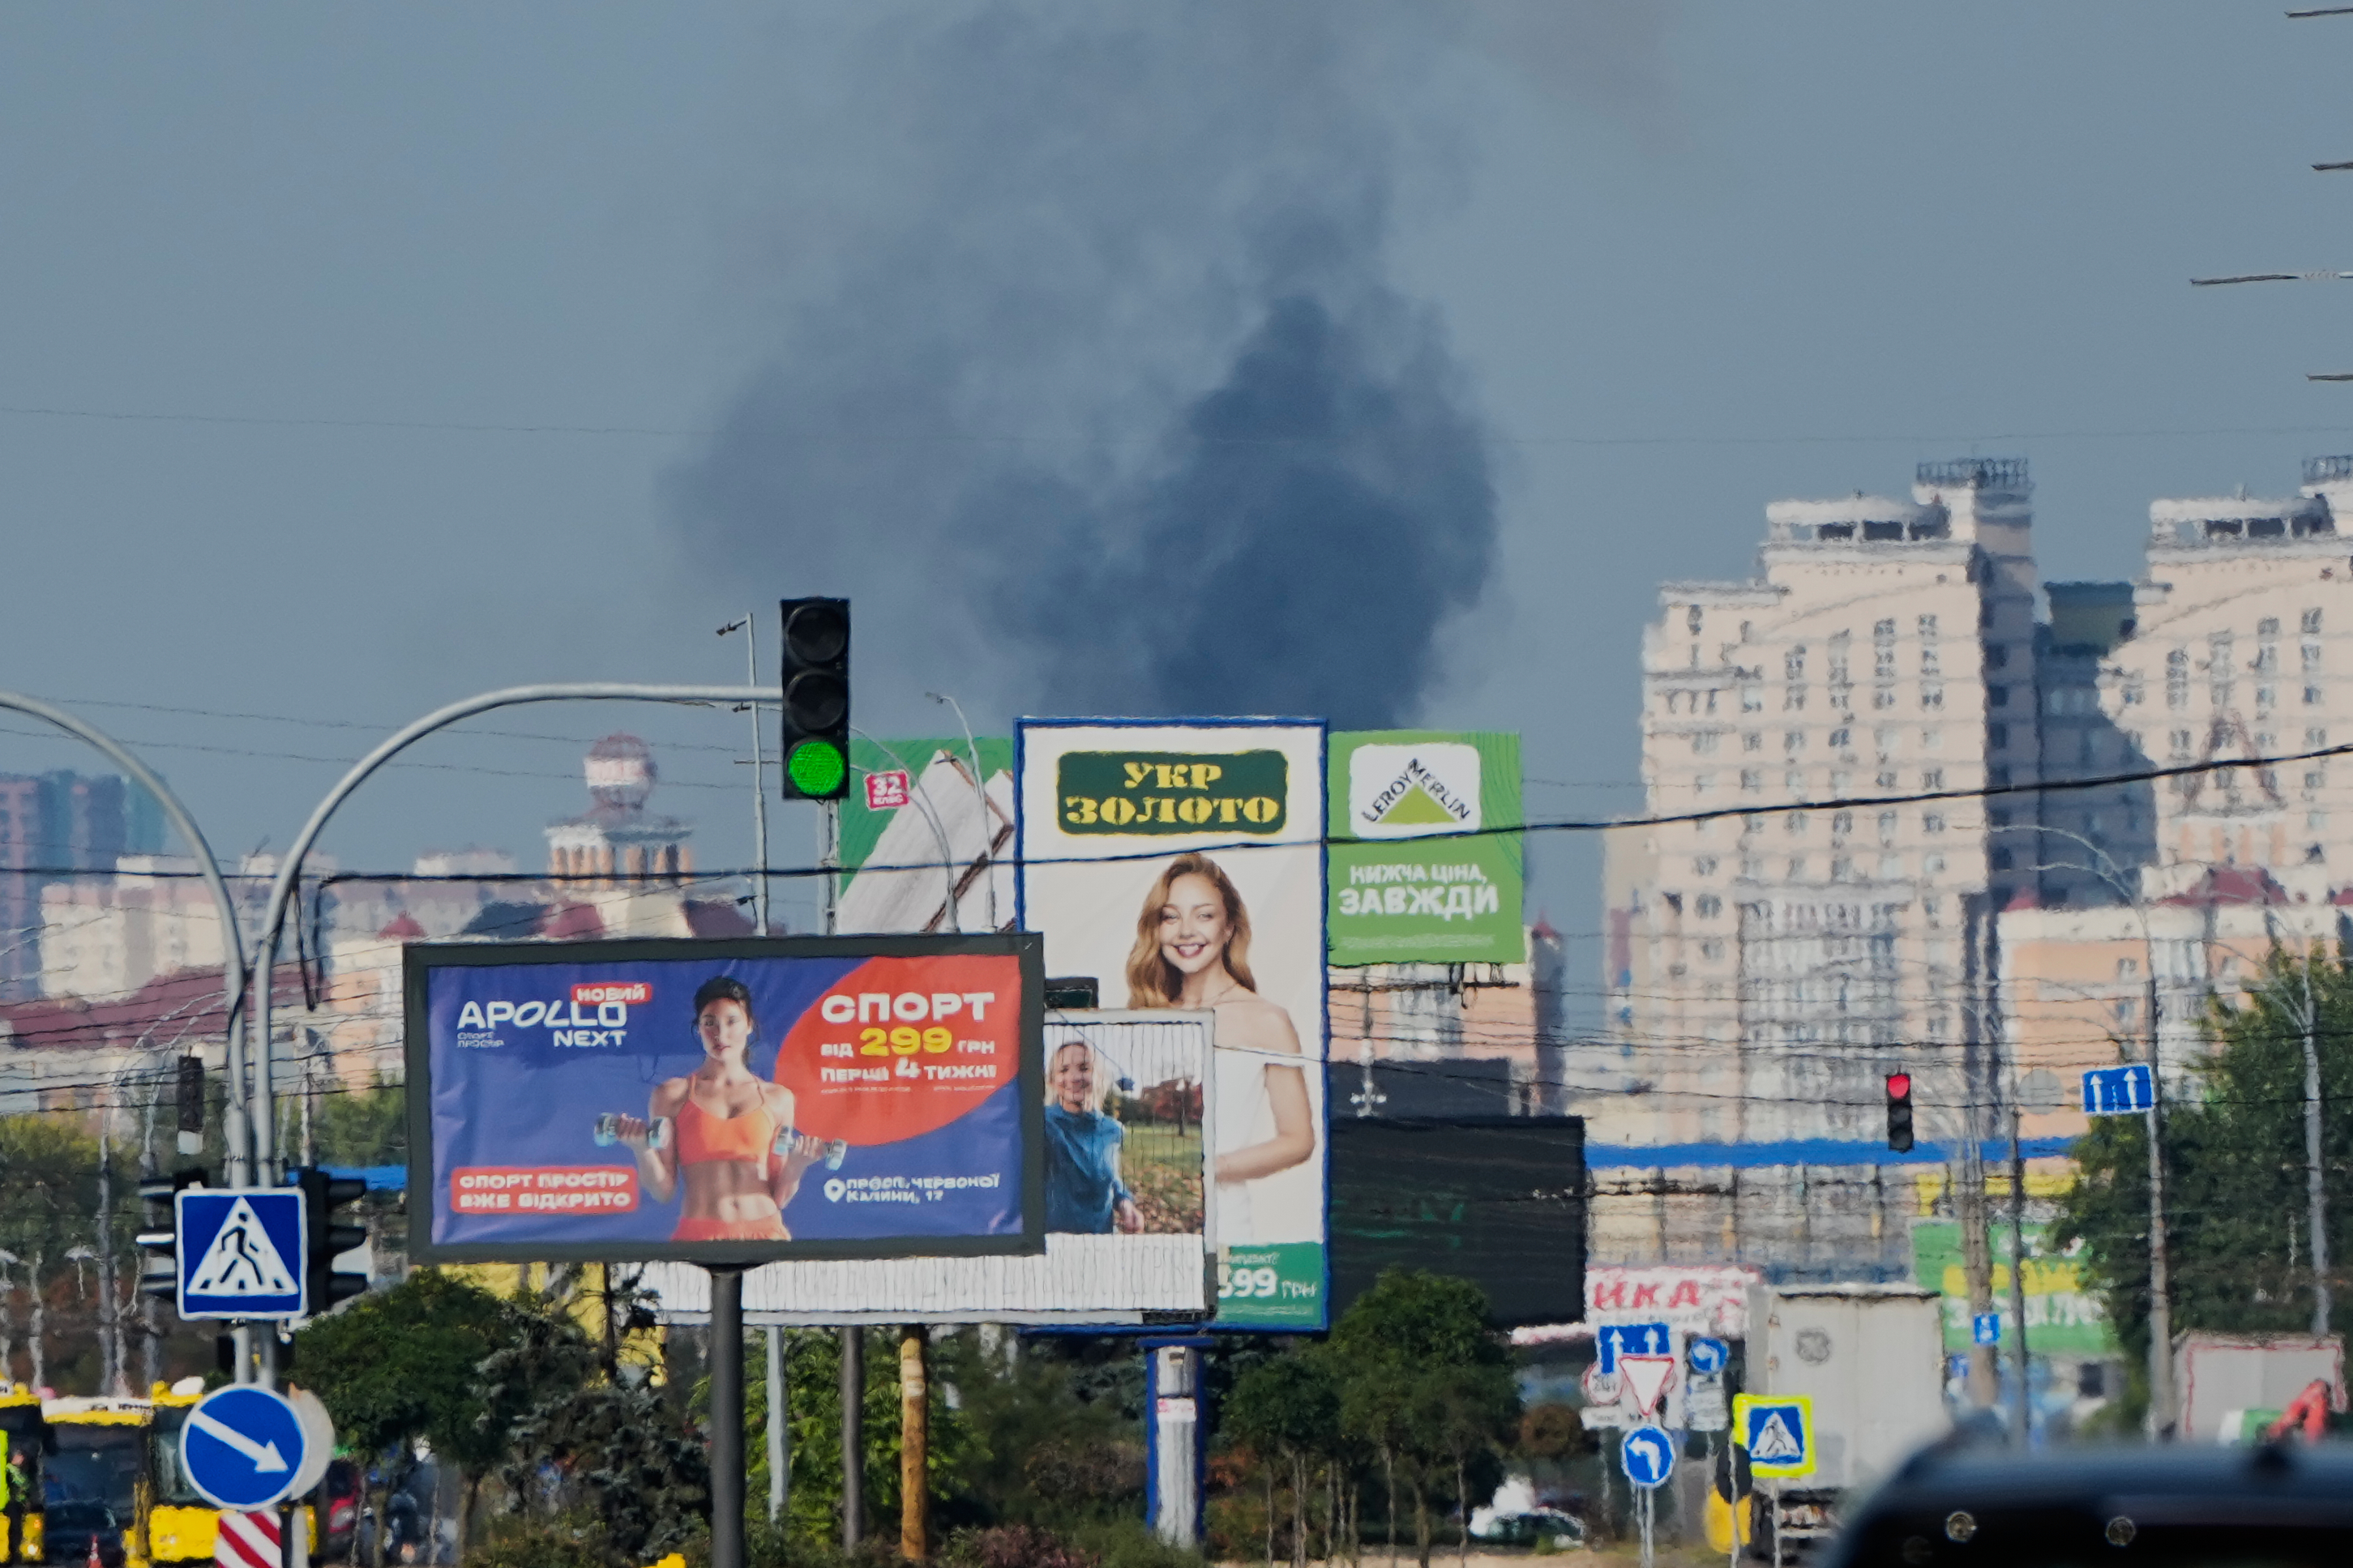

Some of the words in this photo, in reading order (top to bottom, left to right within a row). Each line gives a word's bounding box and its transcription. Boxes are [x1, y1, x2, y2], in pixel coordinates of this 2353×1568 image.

[1123, 761, 1222, 791] УКР
[1362, 771, 1412, 822] LEROY
[1408, 758, 1471, 820] MERLIN
[1061, 796, 1280, 825] ЗОЛОТО
[1350, 864, 1429, 885] НИЖЧА
[1338, 883, 1500, 921] ЗАВЖДИ
[576, 983, 647, 1002] НОВИЙ
[456, 1000, 627, 1030] APOLLO
[821, 992, 995, 1023] СПОРТ
[553, 1030, 627, 1047] NEXT
[820, 1043, 854, 1057] ВІД
[859, 1026, 952, 1057] 299
[956, 1040, 995, 1054] ГРН
[820, 1066, 890, 1083] ПЕРШІ
[895, 1057, 922, 1079] 4
[923, 1064, 997, 1080] ТИЖНІ
[459, 1174, 533, 1189] СПОРТ
[460, 1193, 511, 1208] ВЖЕ
[518, 1192, 631, 1210] ВІДКРИТО
